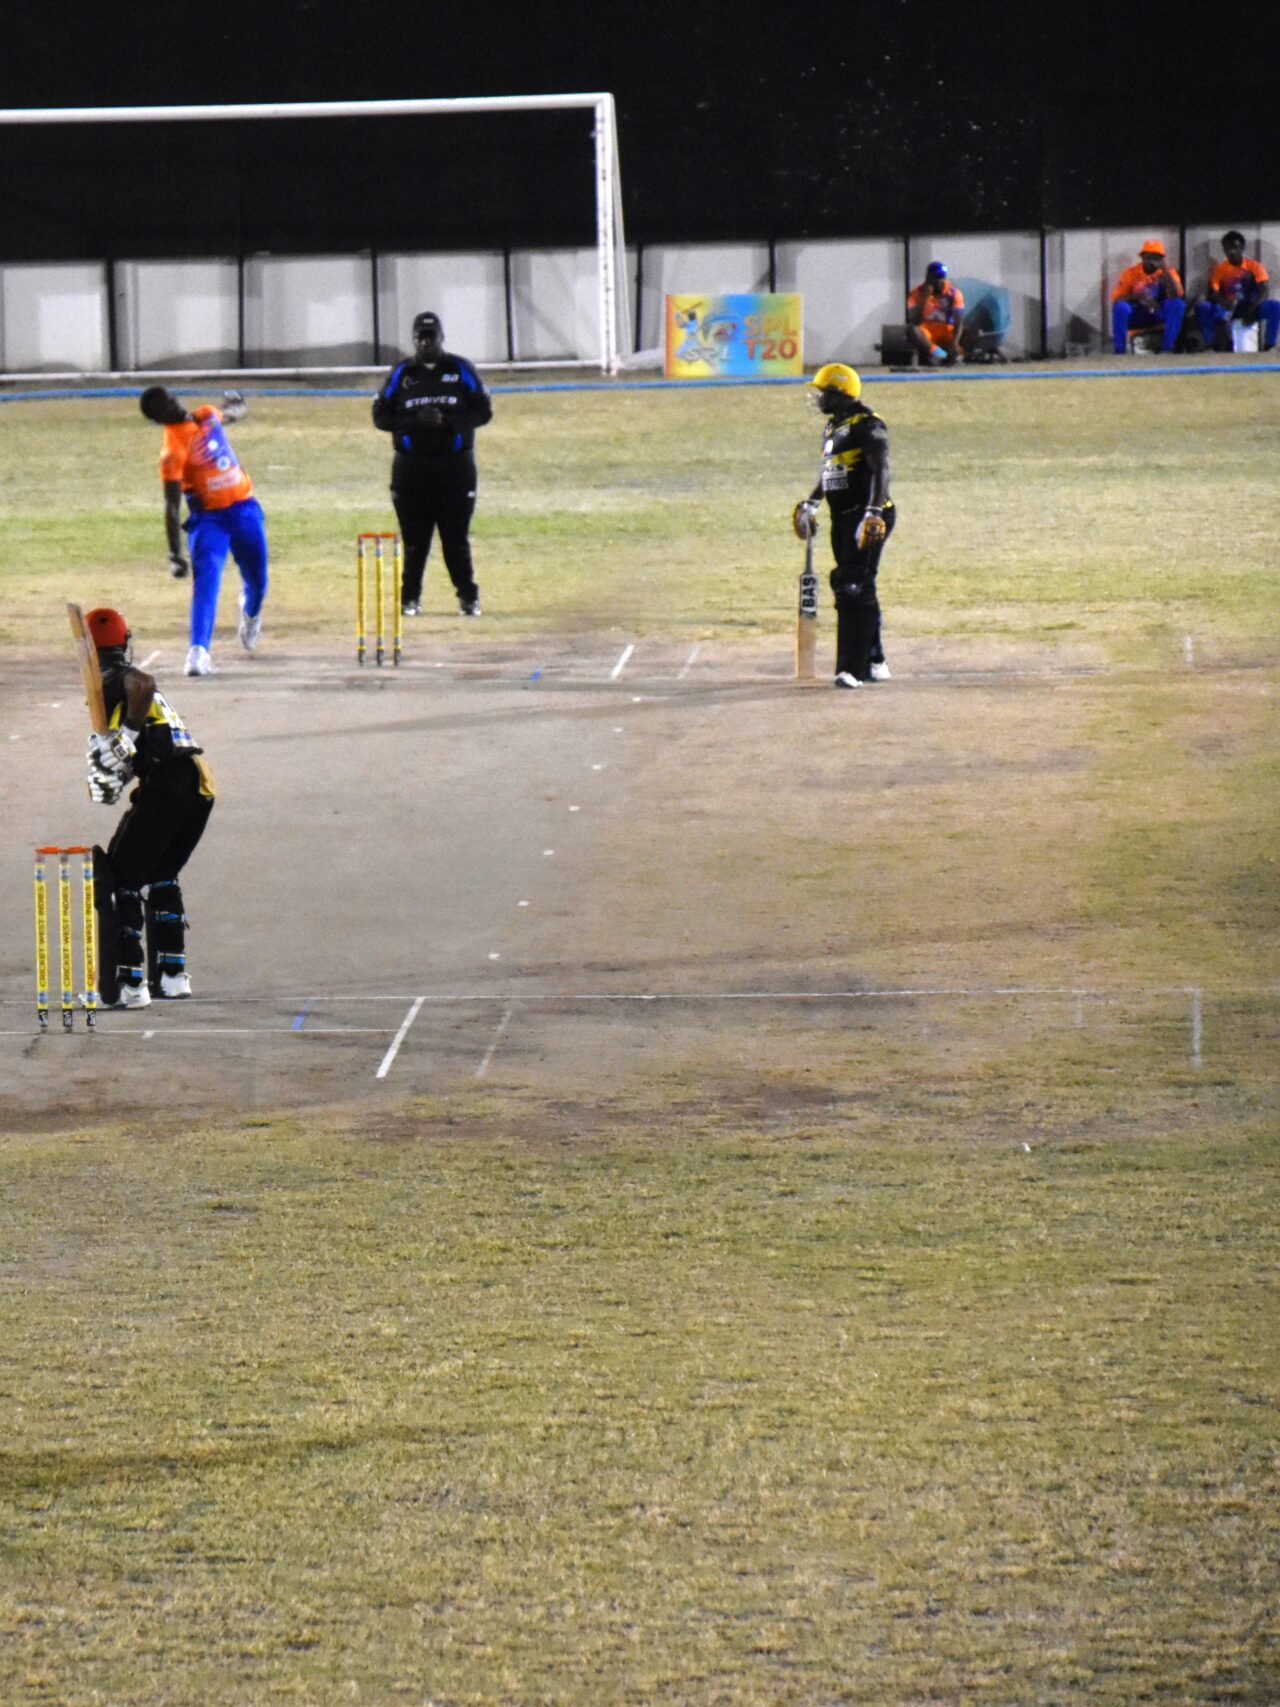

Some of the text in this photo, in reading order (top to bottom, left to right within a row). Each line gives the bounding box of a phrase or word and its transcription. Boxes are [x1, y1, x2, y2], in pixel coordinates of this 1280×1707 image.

[743, 315, 798, 336] SPL
[743, 338, 798, 360] T20
[802, 576, 817, 608] BAS
[84, 884, 93, 915] INDIES
[36, 885, 46, 988] CRICKET WEST INDIES
[61, 885, 71, 987] CRICKET WEST INDIES
